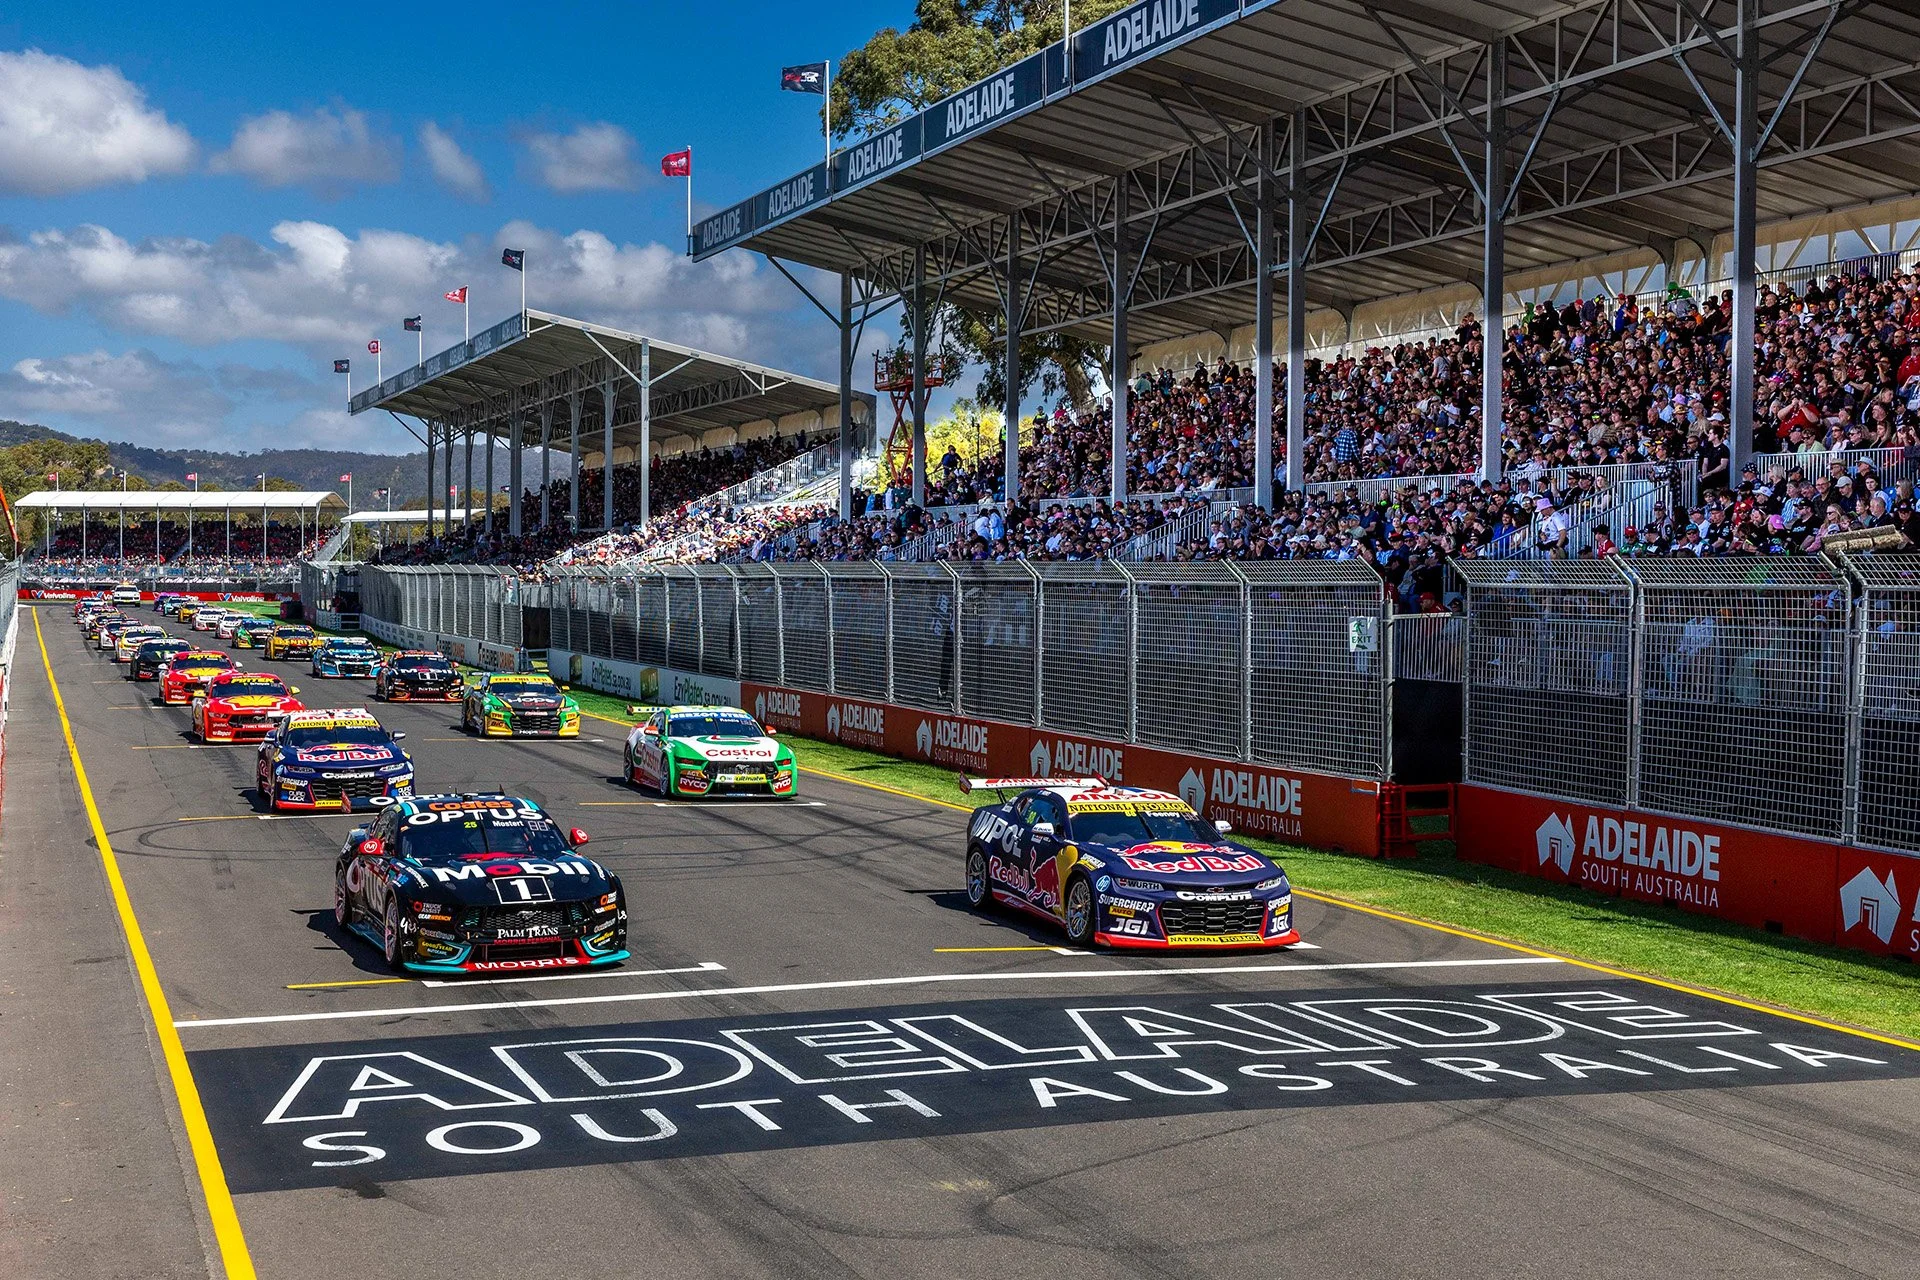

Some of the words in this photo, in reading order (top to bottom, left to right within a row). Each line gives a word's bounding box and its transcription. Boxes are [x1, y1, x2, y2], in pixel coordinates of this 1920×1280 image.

[1103, 0, 1199, 66] ADELAIDE
[945, 73, 1015, 138] ADELAIDE
[848, 128, 903, 183] ADELAIDE
[768, 172, 814, 220] ADELAIDE
[702, 208, 740, 249] ADELAIDE
[1352, 635, 1372, 643] EXIT
[767, 691, 800, 717] ADELAIDE
[842, 704, 883, 733] ADELAIDE
[842, 729, 858, 743] SOUTH
[858, 733, 883, 748] AUSTRALIA
[935, 720, 987, 753] ADELAIDE
[297, 751, 347, 762] Red
[347, 748, 393, 761] Bull
[705, 747, 772, 758] Castrol
[935, 748, 953, 762] SOUTH
[954, 752, 987, 770] AUSTRALIA
[1055, 740, 1123, 781] ADELAIDE
[680, 777, 707, 789] RYCO
[1210, 768, 1301, 816] ADELAIDE
[408, 808, 543, 825] OPTUS
[428, 800, 515, 811] Coates
[1068, 803, 1132, 813] NATIONAL
[1135, 803, 1189, 811] STORAGE
[463, 821, 478, 829] 25
[493, 820, 524, 828] Mostert
[1210, 805, 1242, 826] SOUTH
[1246, 812, 1301, 837] AUSTRALIA
[970, 810, 1024, 858] AMPOL
[1583, 815, 1720, 882] ADELAIDE
[432, 861, 590, 881] Mobil
[1119, 856, 1205, 873] Red
[1201, 854, 1267, 872] Bull
[990, 855, 1015, 887] Red
[1013, 866, 1030, 896] Bull
[1581, 861, 1629, 888] SOUTH
[1635, 872, 1719, 908] AUSTRALIA
[509, 878, 532, 900] 1
[422, 902, 442, 910] TRUCK
[1098, 893, 1155, 913] SUPERCHEAP
[1111, 908, 1133, 916] AUTO
[497, 928, 525, 939] PALM
[526, 926, 559, 938] TRANS
[1109, 917, 1150, 935] JGI
[474, 957, 581, 971] MORRIS
[263, 989, 1762, 1125] ADELAIDE
[301, 1088, 943, 1168] SOUTH
[1028, 1041, 1889, 1109] AUSTRALIA
